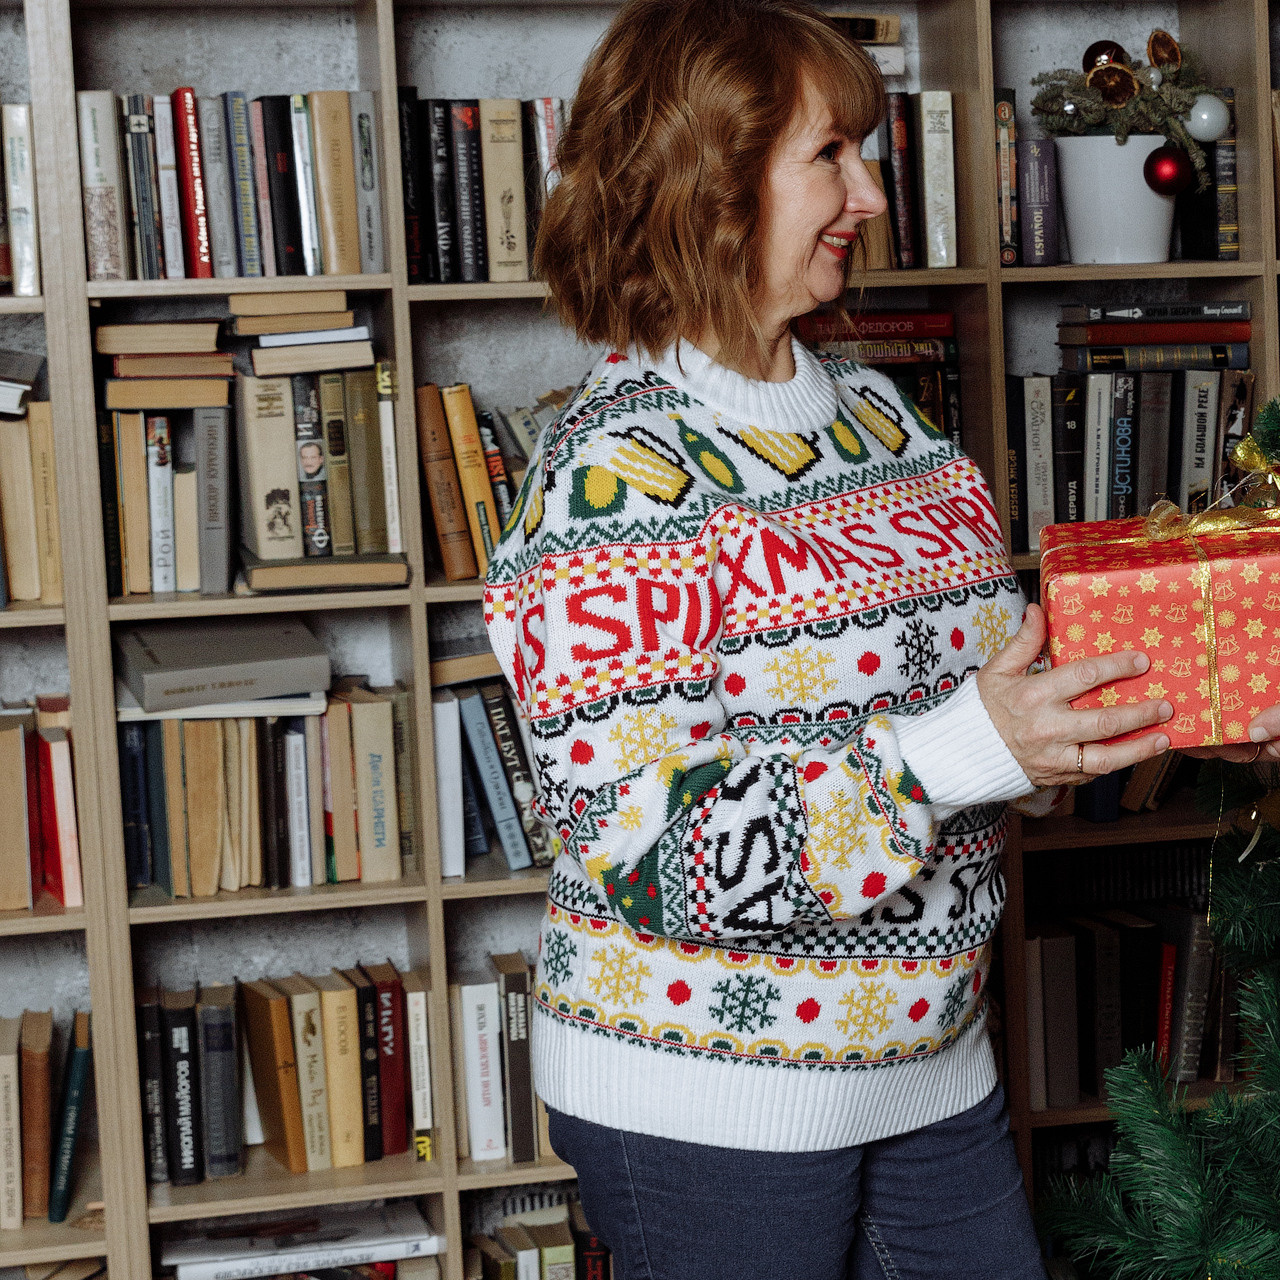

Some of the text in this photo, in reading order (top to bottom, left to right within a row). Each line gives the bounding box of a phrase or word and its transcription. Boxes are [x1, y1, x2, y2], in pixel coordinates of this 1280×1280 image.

[457, 142, 474, 264] АРТУРО ПЕРЕС-РЕВЕРТЕ
[1029, 208, 1044, 255] ESPAÑOL
[858, 321, 914, 334] ФЕДОРОВ
[1146, 307, 1169, 317] ЮРИЙ
[857, 343, 910, 358] ПЕРУМОВ
[1029, 400, 1041, 451] СИМЕНОН
[1066, 419, 1078, 430] 18
[1193, 387, 1209, 468] НА БОЛЬШОЙ РЕКЕ
[206, 424, 220, 521] ВИКТОР КУРОЧКИН
[1112, 416, 1132, 494] УСТИНОВА
[1068, 480, 1077, 519] КЕРВУД
[722, 520, 901, 602] XMAS
[490, 706, 511, 738] ПАТ
[499, 738, 521, 770] БУТ
[371, 790, 386, 849] КАРНЕГИ
[508, 991, 517, 1040] ПОЛЬСКИЙ
[518, 992, 527, 1038] ДЕТЕКТИВ
[476, 1003, 491, 1106] АНТОН ПАВЛОВИЧ ЧЕХОВ
[174, 1060, 194, 1167] НИКОЛАЙ МАЙОРОВ
